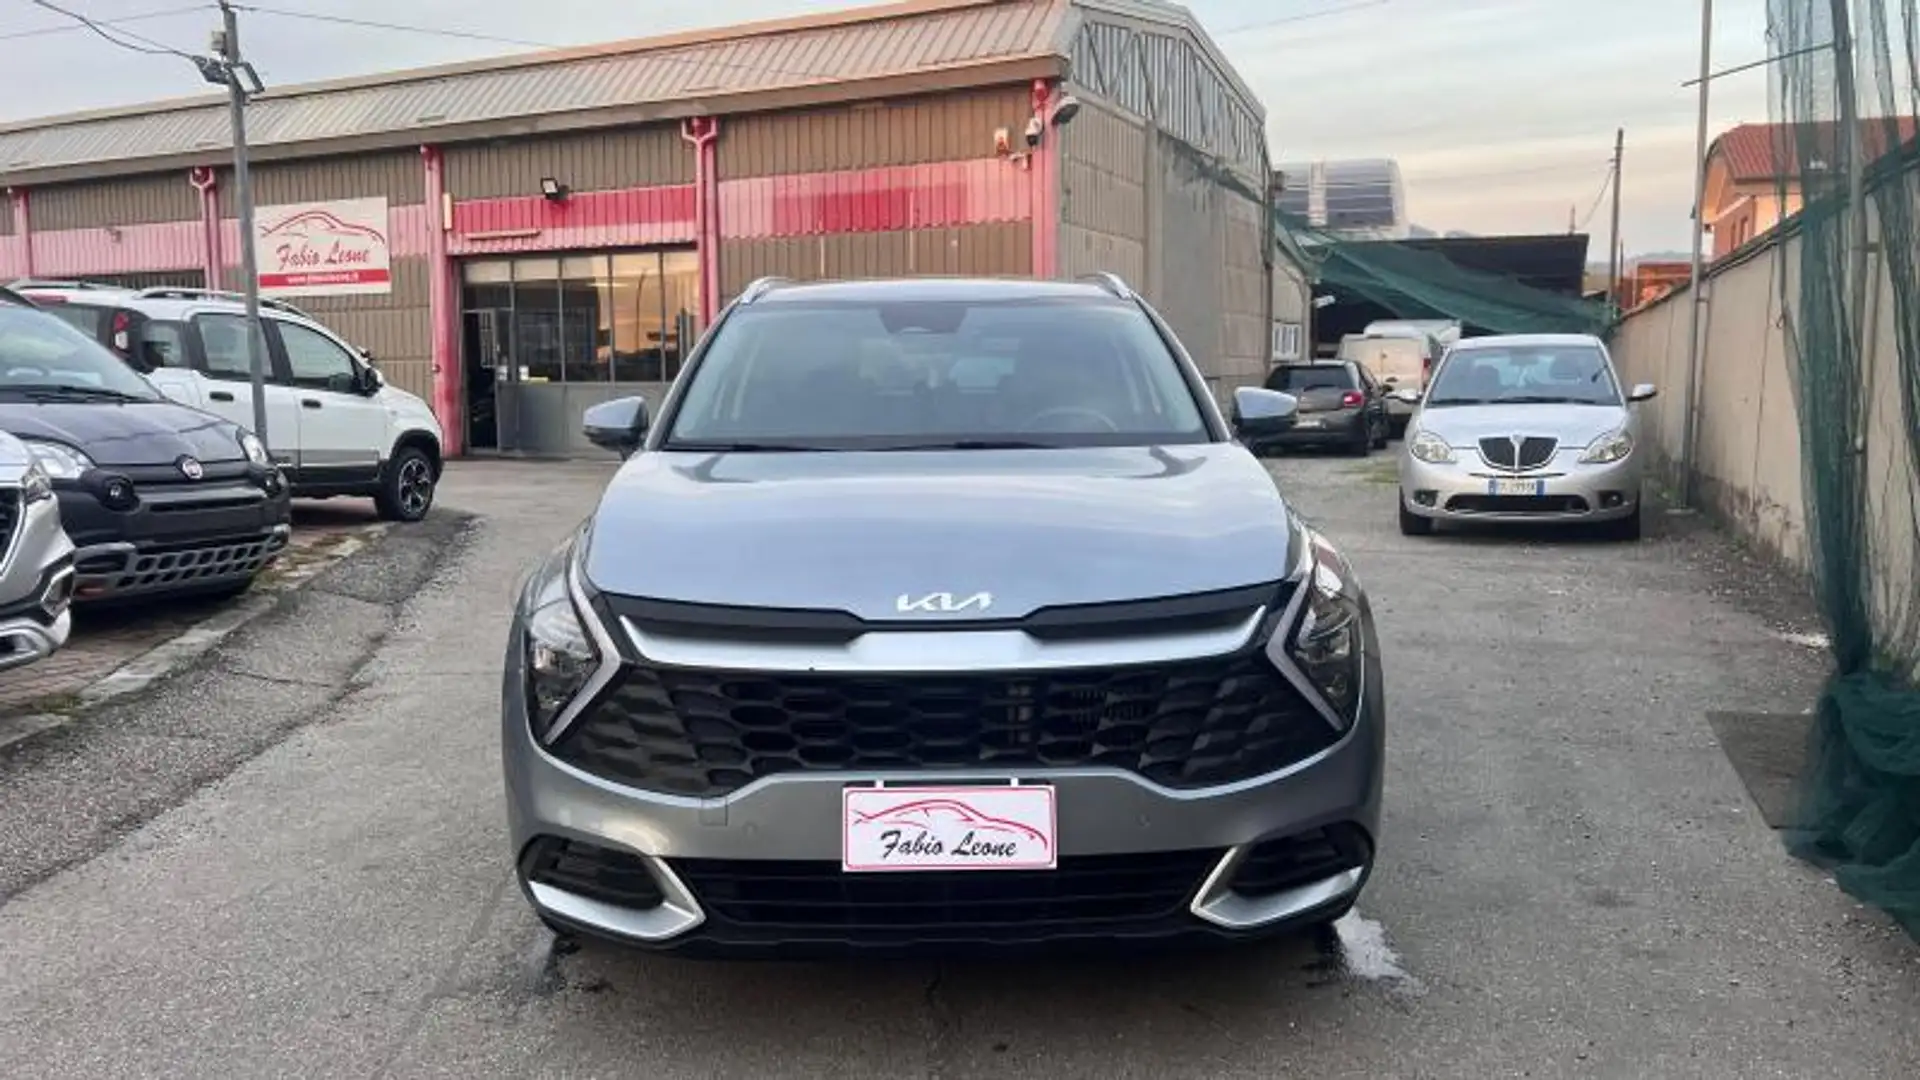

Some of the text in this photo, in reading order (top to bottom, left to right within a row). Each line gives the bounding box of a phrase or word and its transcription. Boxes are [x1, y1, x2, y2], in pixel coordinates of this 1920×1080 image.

[276, 239, 369, 271] Fabio Leone
[880, 830, 1017, 859] Fabio Leone
